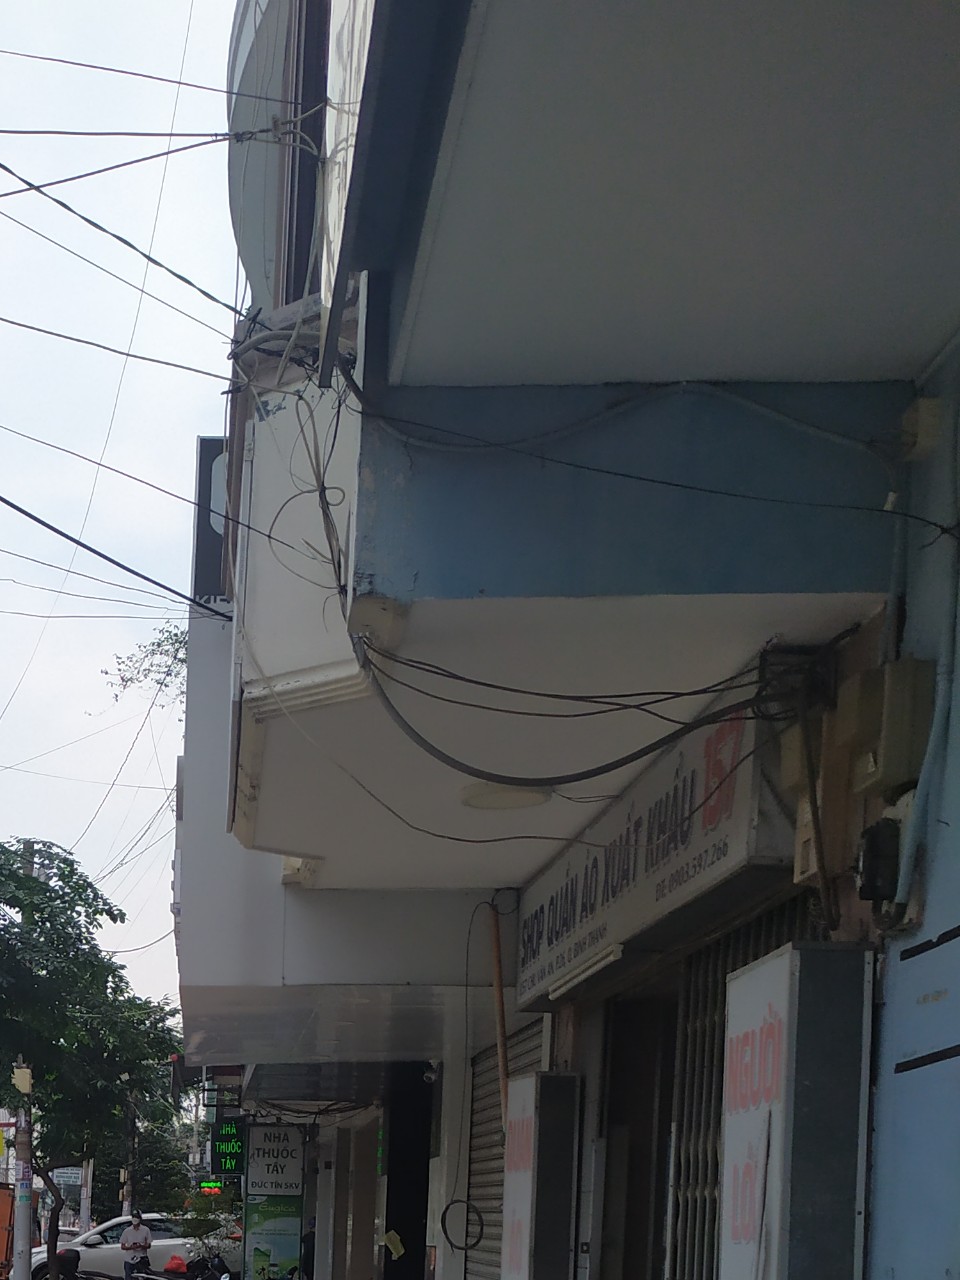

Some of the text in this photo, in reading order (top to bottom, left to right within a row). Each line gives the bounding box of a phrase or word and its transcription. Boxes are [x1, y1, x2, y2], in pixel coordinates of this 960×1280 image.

[521, 904, 545, 970] SHOP
[215, 1139, 242, 1154] THUỐC
[221, 1156, 237, 1170] TÂY
[258, 1201, 296, 1214] Eugica
